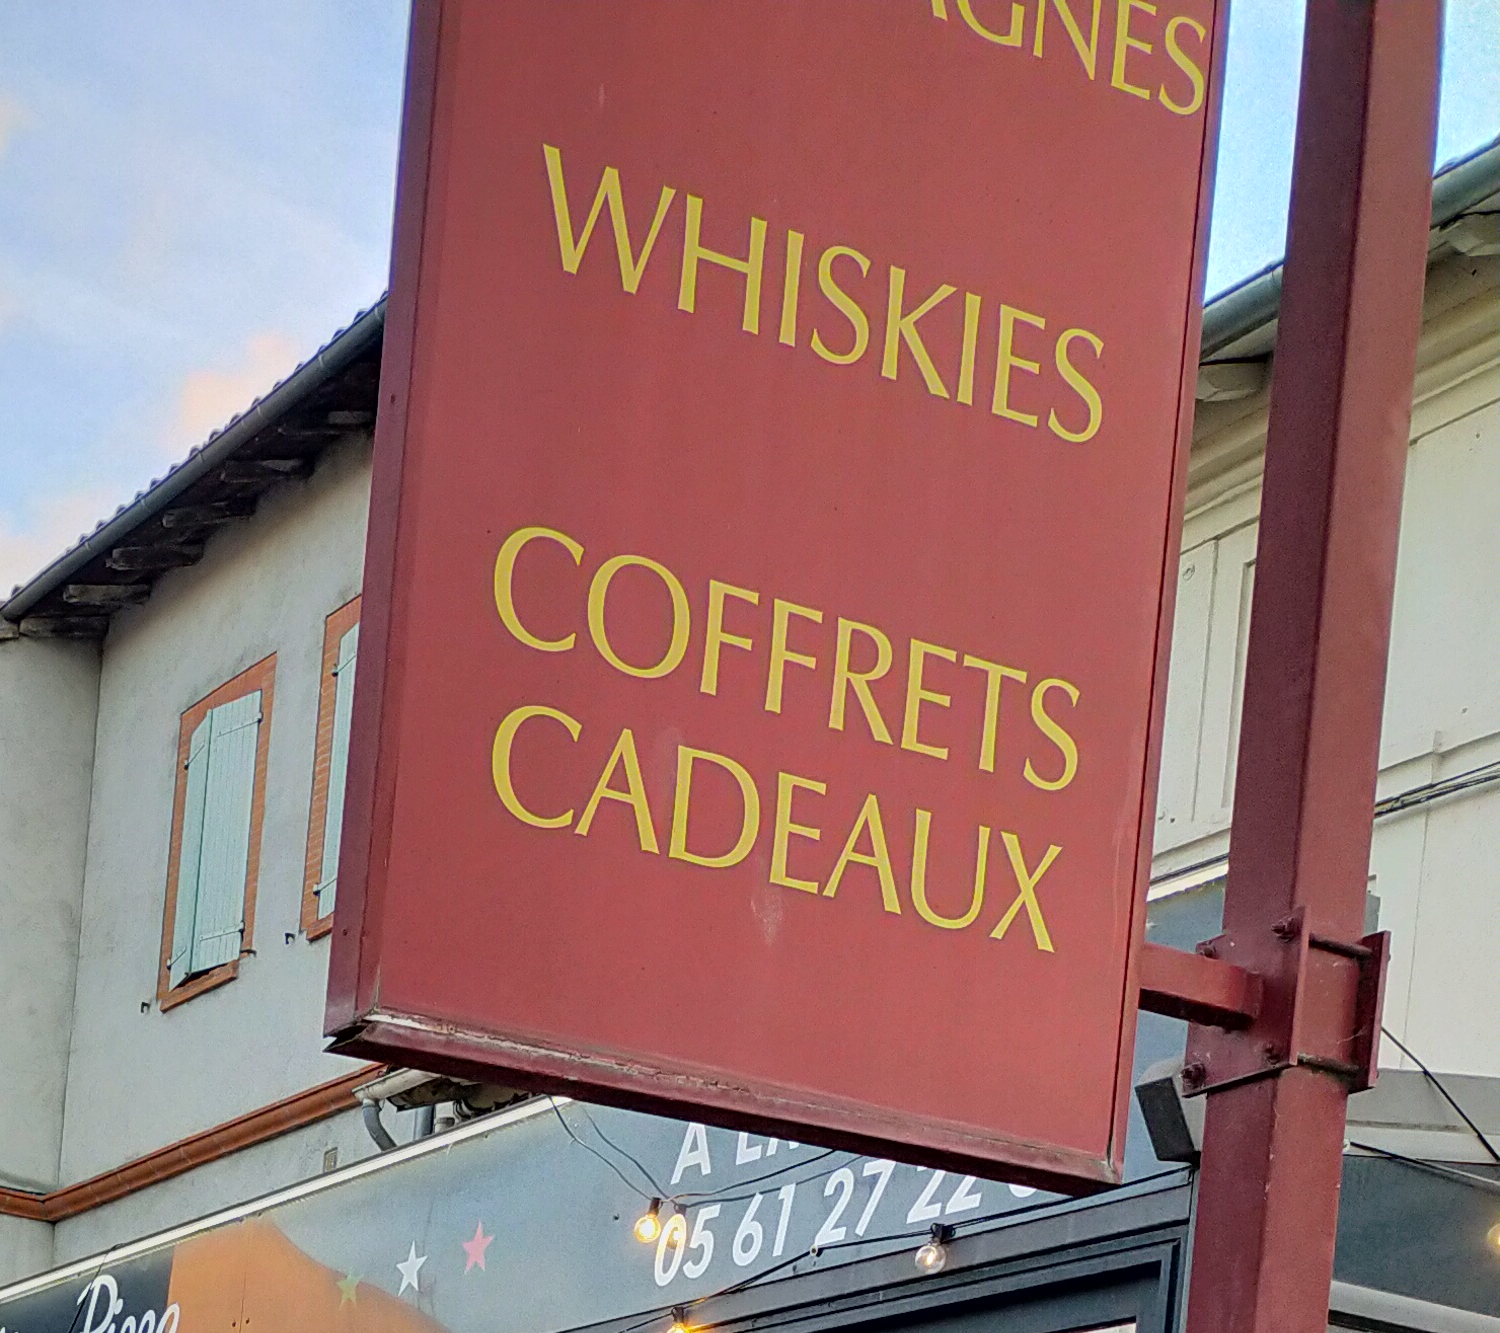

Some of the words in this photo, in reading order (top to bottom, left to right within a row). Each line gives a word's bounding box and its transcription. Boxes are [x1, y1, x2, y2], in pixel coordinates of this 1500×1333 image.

[931, 0, 1207, 116] GNES
[541, 143, 1104, 445] WHISKIES
[494, 526, 1081, 792] COFFRETS
[491, 705, 1063, 954] CADEAUX
[654, 1205, 715, 1287] 05
[733, 1183, 796, 1268] 61
[812, 1157, 889, 1248] 27
